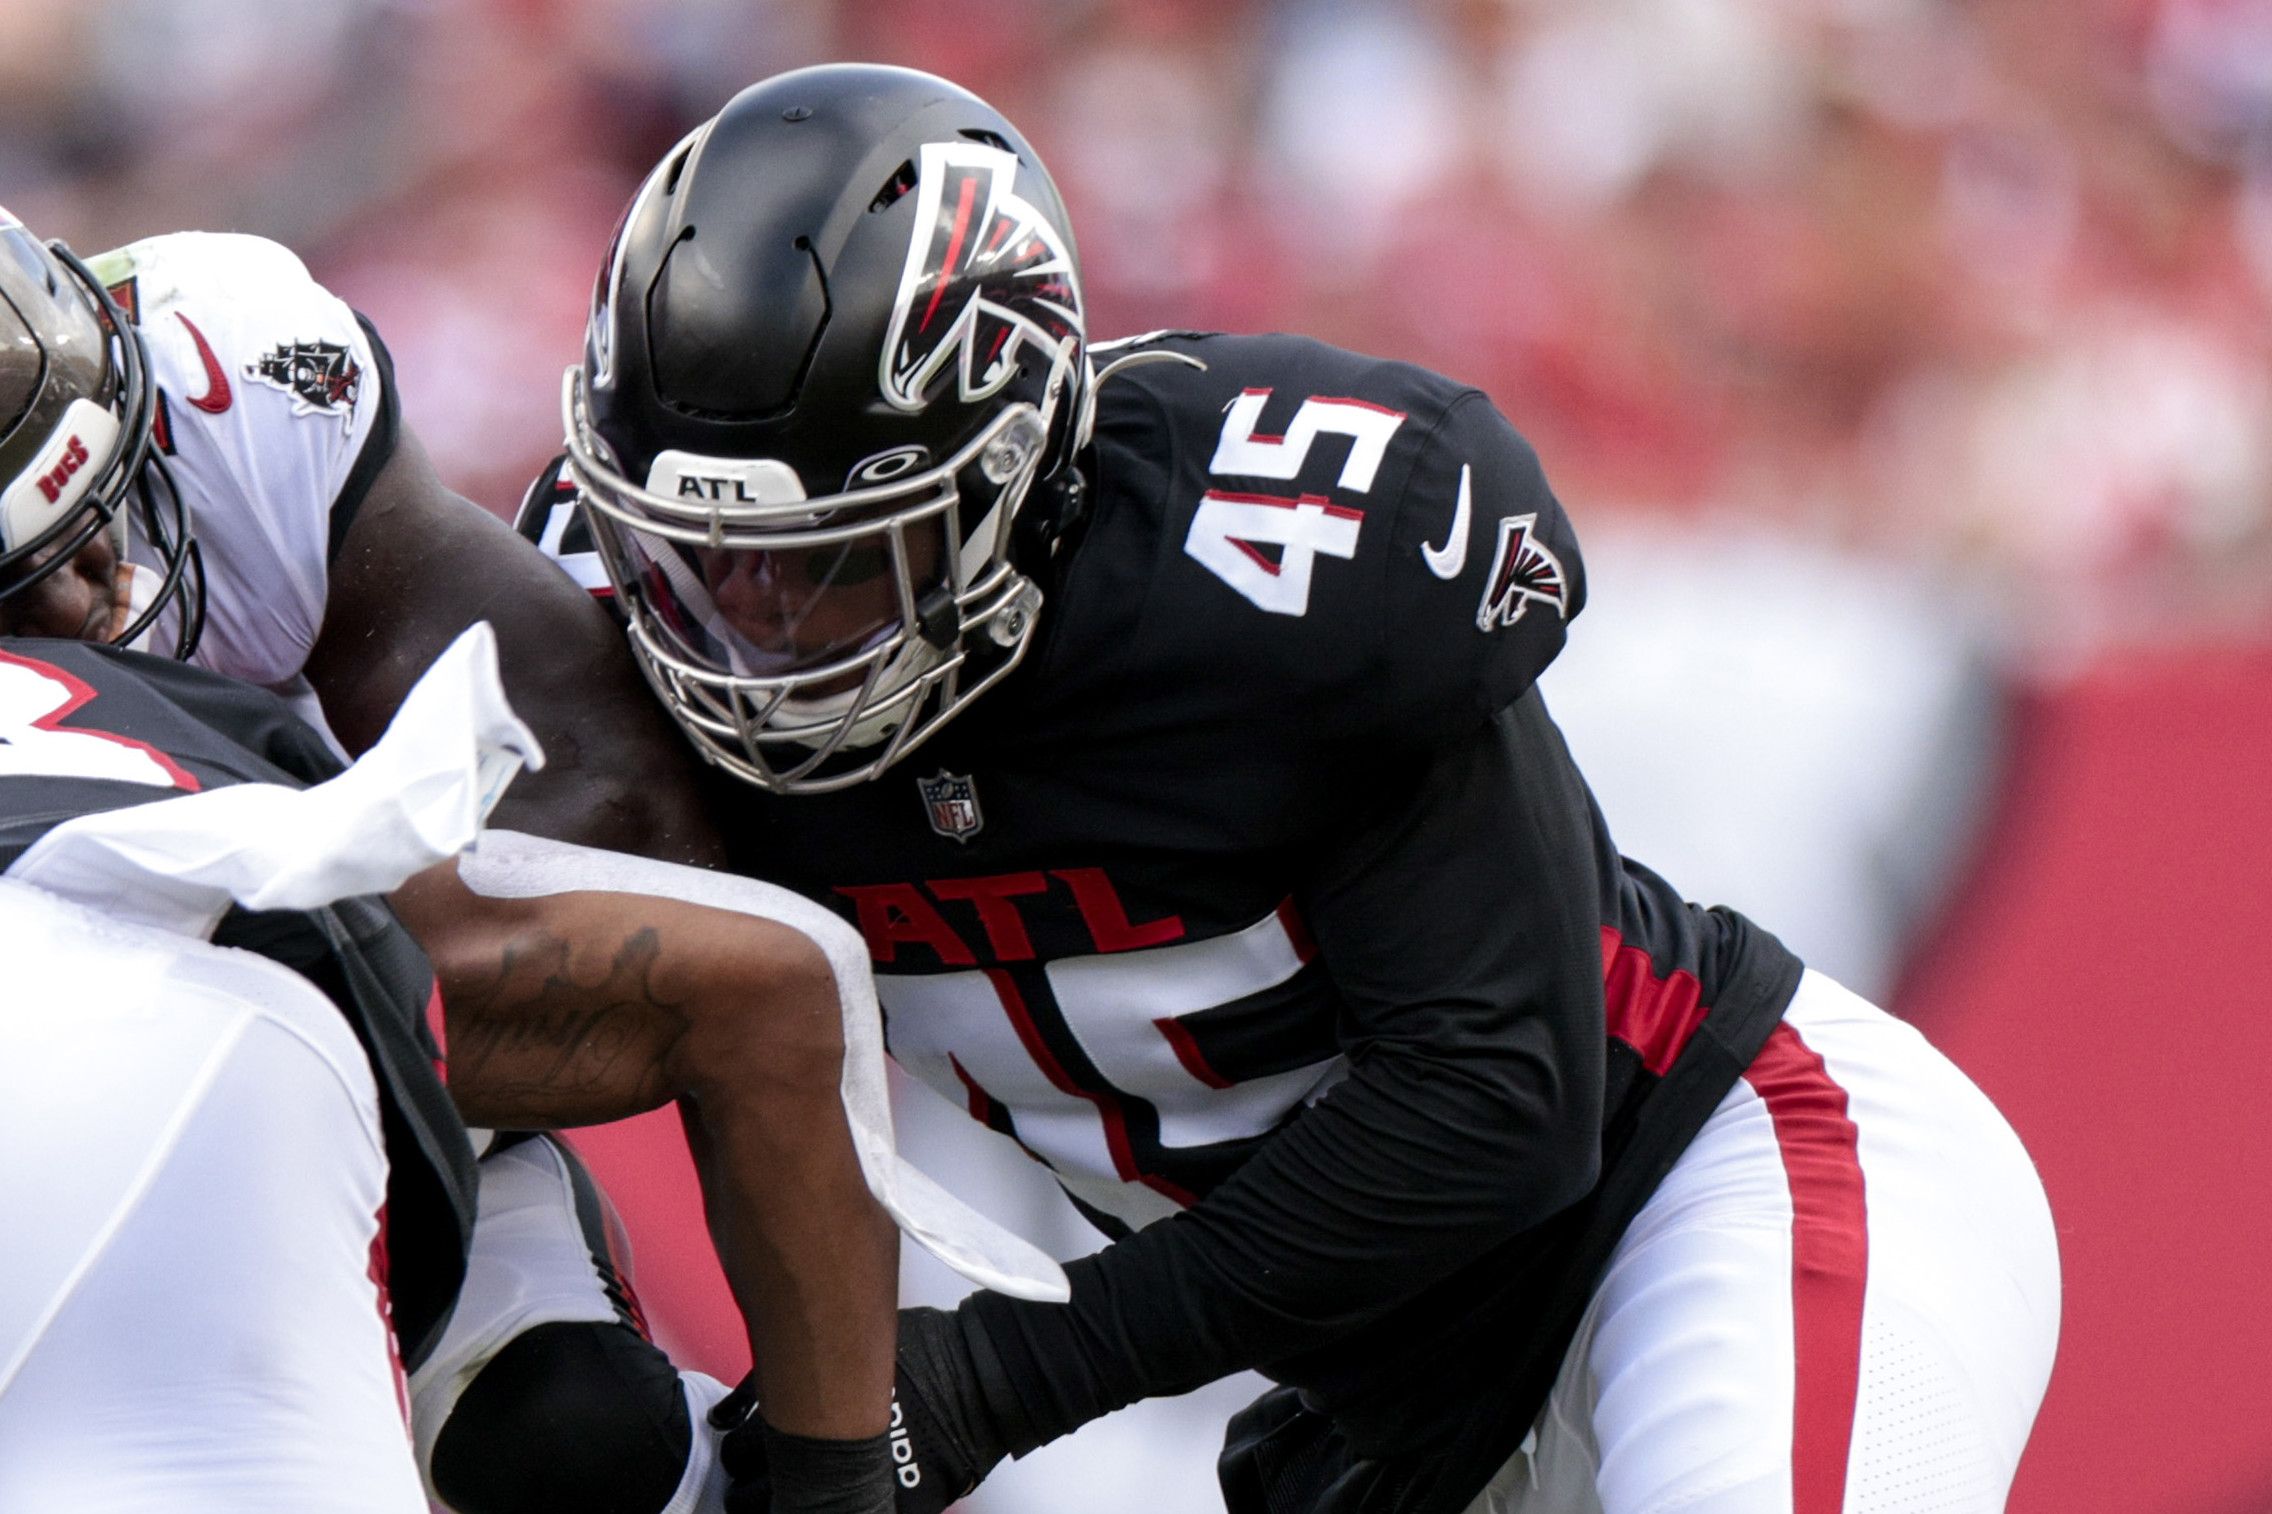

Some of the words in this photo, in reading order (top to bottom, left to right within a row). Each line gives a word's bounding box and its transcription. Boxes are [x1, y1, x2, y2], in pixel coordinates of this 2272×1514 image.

[678, 475, 757, 502] ATL
[1184, 387, 1407, 617] 45
[932, 801, 976, 830] NFL
[834, 867, 1186, 964] ATL
